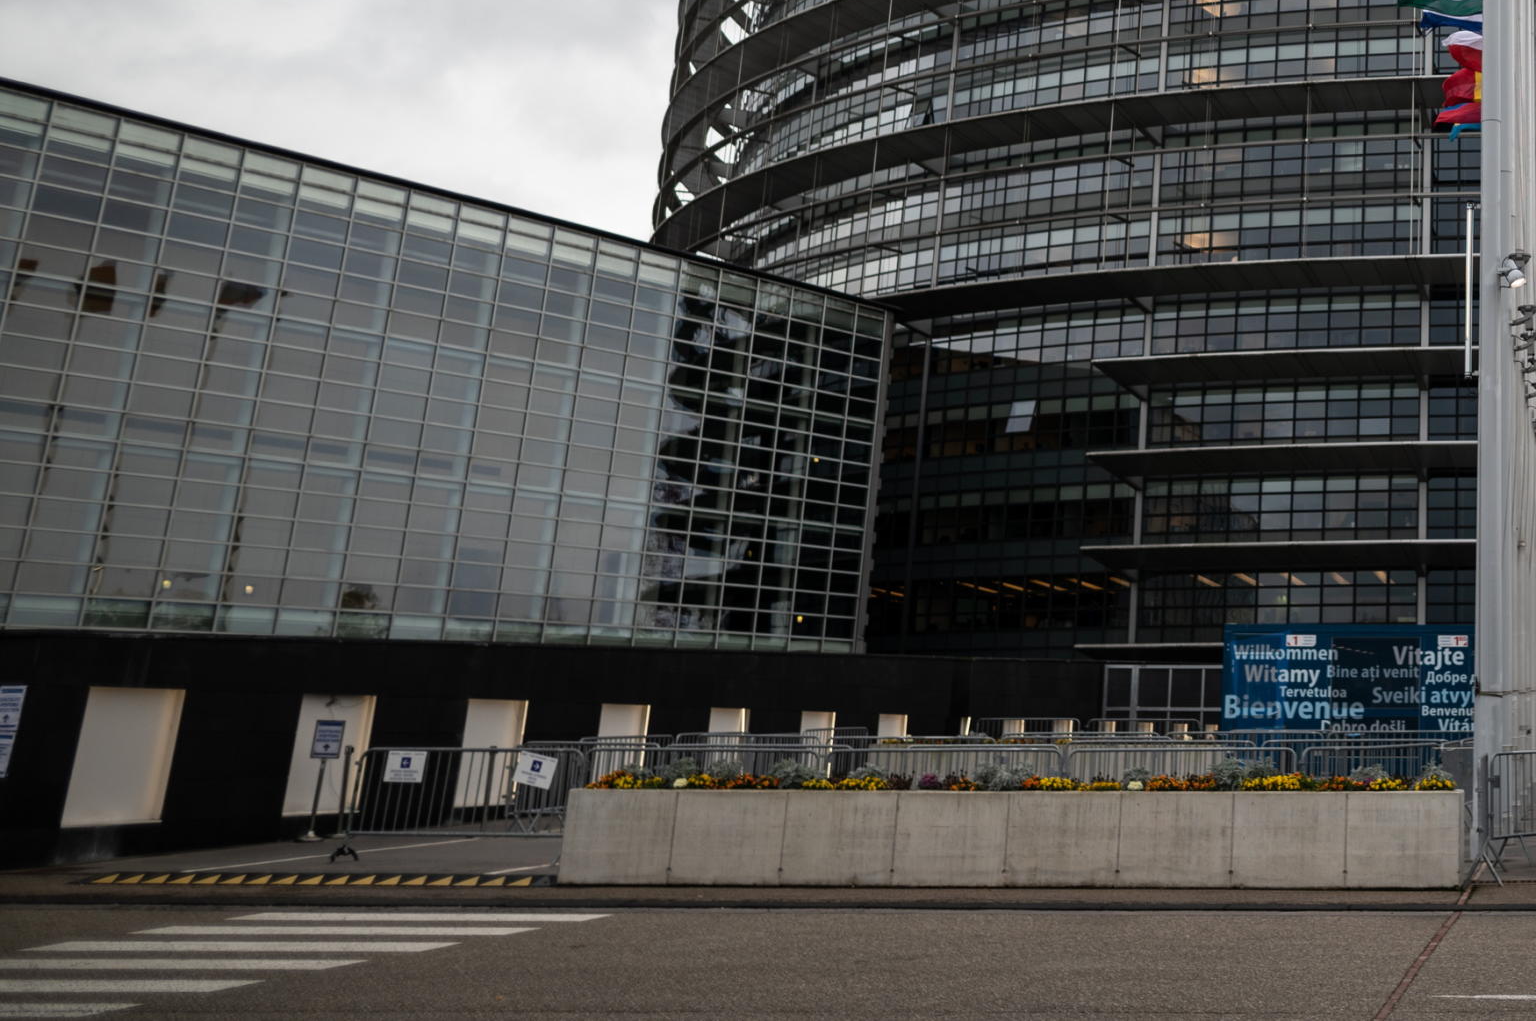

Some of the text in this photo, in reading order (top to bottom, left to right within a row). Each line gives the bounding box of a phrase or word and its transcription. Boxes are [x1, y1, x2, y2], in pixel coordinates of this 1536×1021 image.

[1233, 644, 1339, 661] Willkommen
[1392, 645, 1465, 670] Vitajte
[1244, 664, 1320, 687] Witamy
[1326, 665, 1358, 678] Bine
[1383, 665, 1420, 678] venit
[1425, 671, 1468, 686] Добре
[1279, 686, 1347, 698] Tervetuloa
[1372, 686, 1426, 704] Sveiki
[1224, 694, 1365, 720] Bienvenue
[1321, 719, 1367, 732] Dobro
